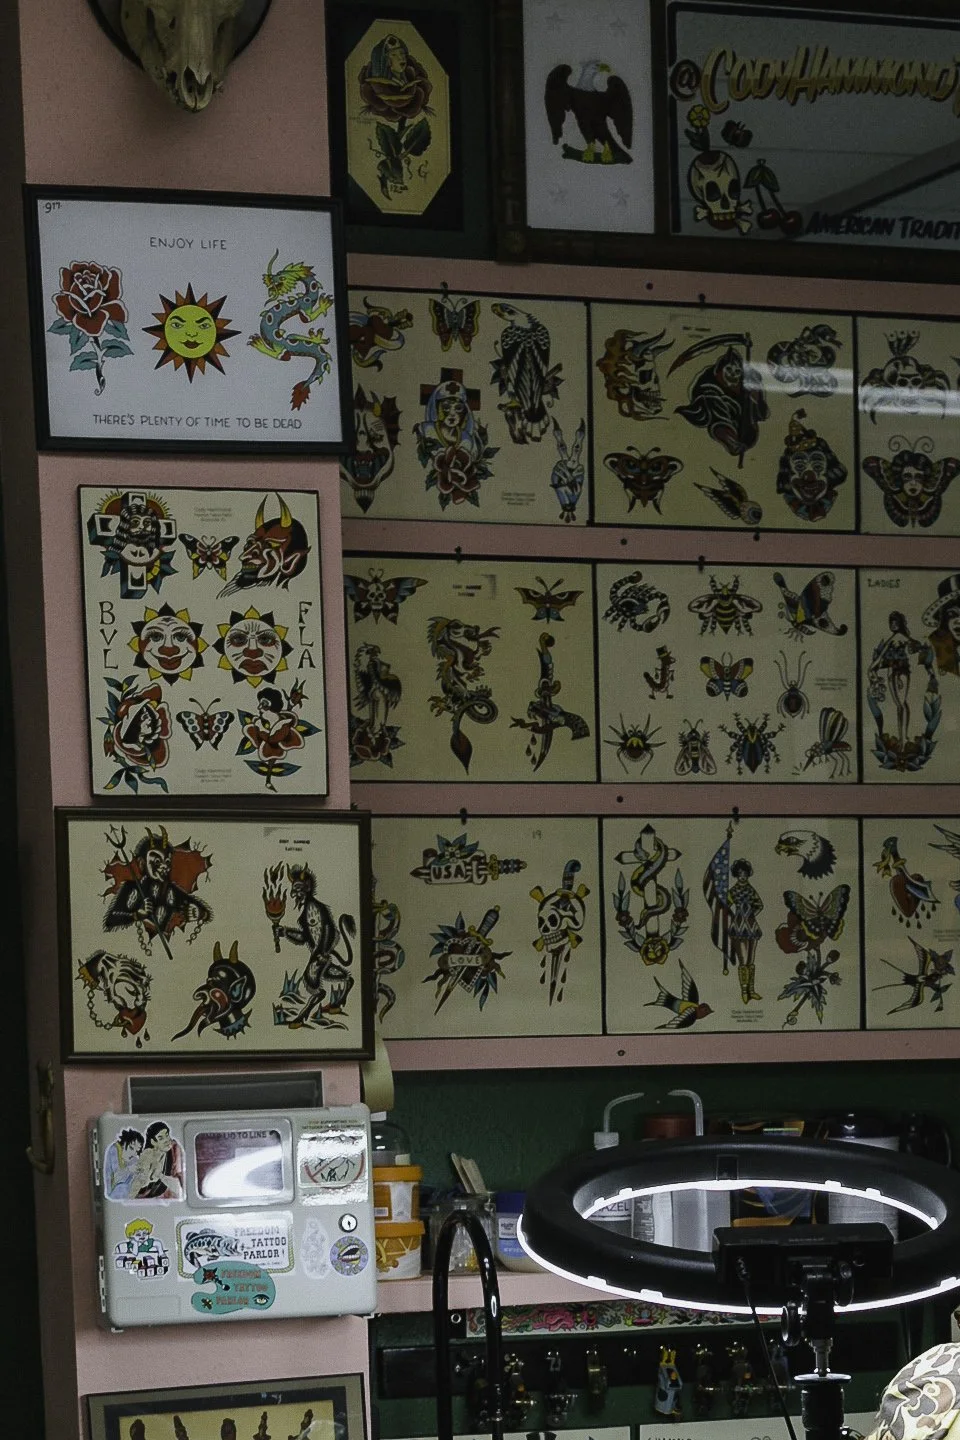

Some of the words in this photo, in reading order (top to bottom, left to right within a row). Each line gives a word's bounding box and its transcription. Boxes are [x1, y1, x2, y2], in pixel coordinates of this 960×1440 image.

[804, 210, 895, 237] AMERICAN
[149, 236, 194, 249] ENJOY
[200, 237, 228, 250] LIFE
[93, 412, 135, 425] THERE'S
[140, 414, 182, 427] PLENTY
[185, 416, 202, 427] OF
[203, 416, 230, 428] TIME
[235, 417, 251, 428] TO
[254, 418, 269, 428] BE
[272, 418, 302, 429] DEAD
[431, 863, 465, 880] USA
[449, 956, 480, 966] LOVE
[249, 1130, 267, 1139] LINE
[597, 1201, 629, 1212] AZEL
[250, 1236, 287, 1248] TATTOO
[242, 1248, 280, 1260] PARLOR
